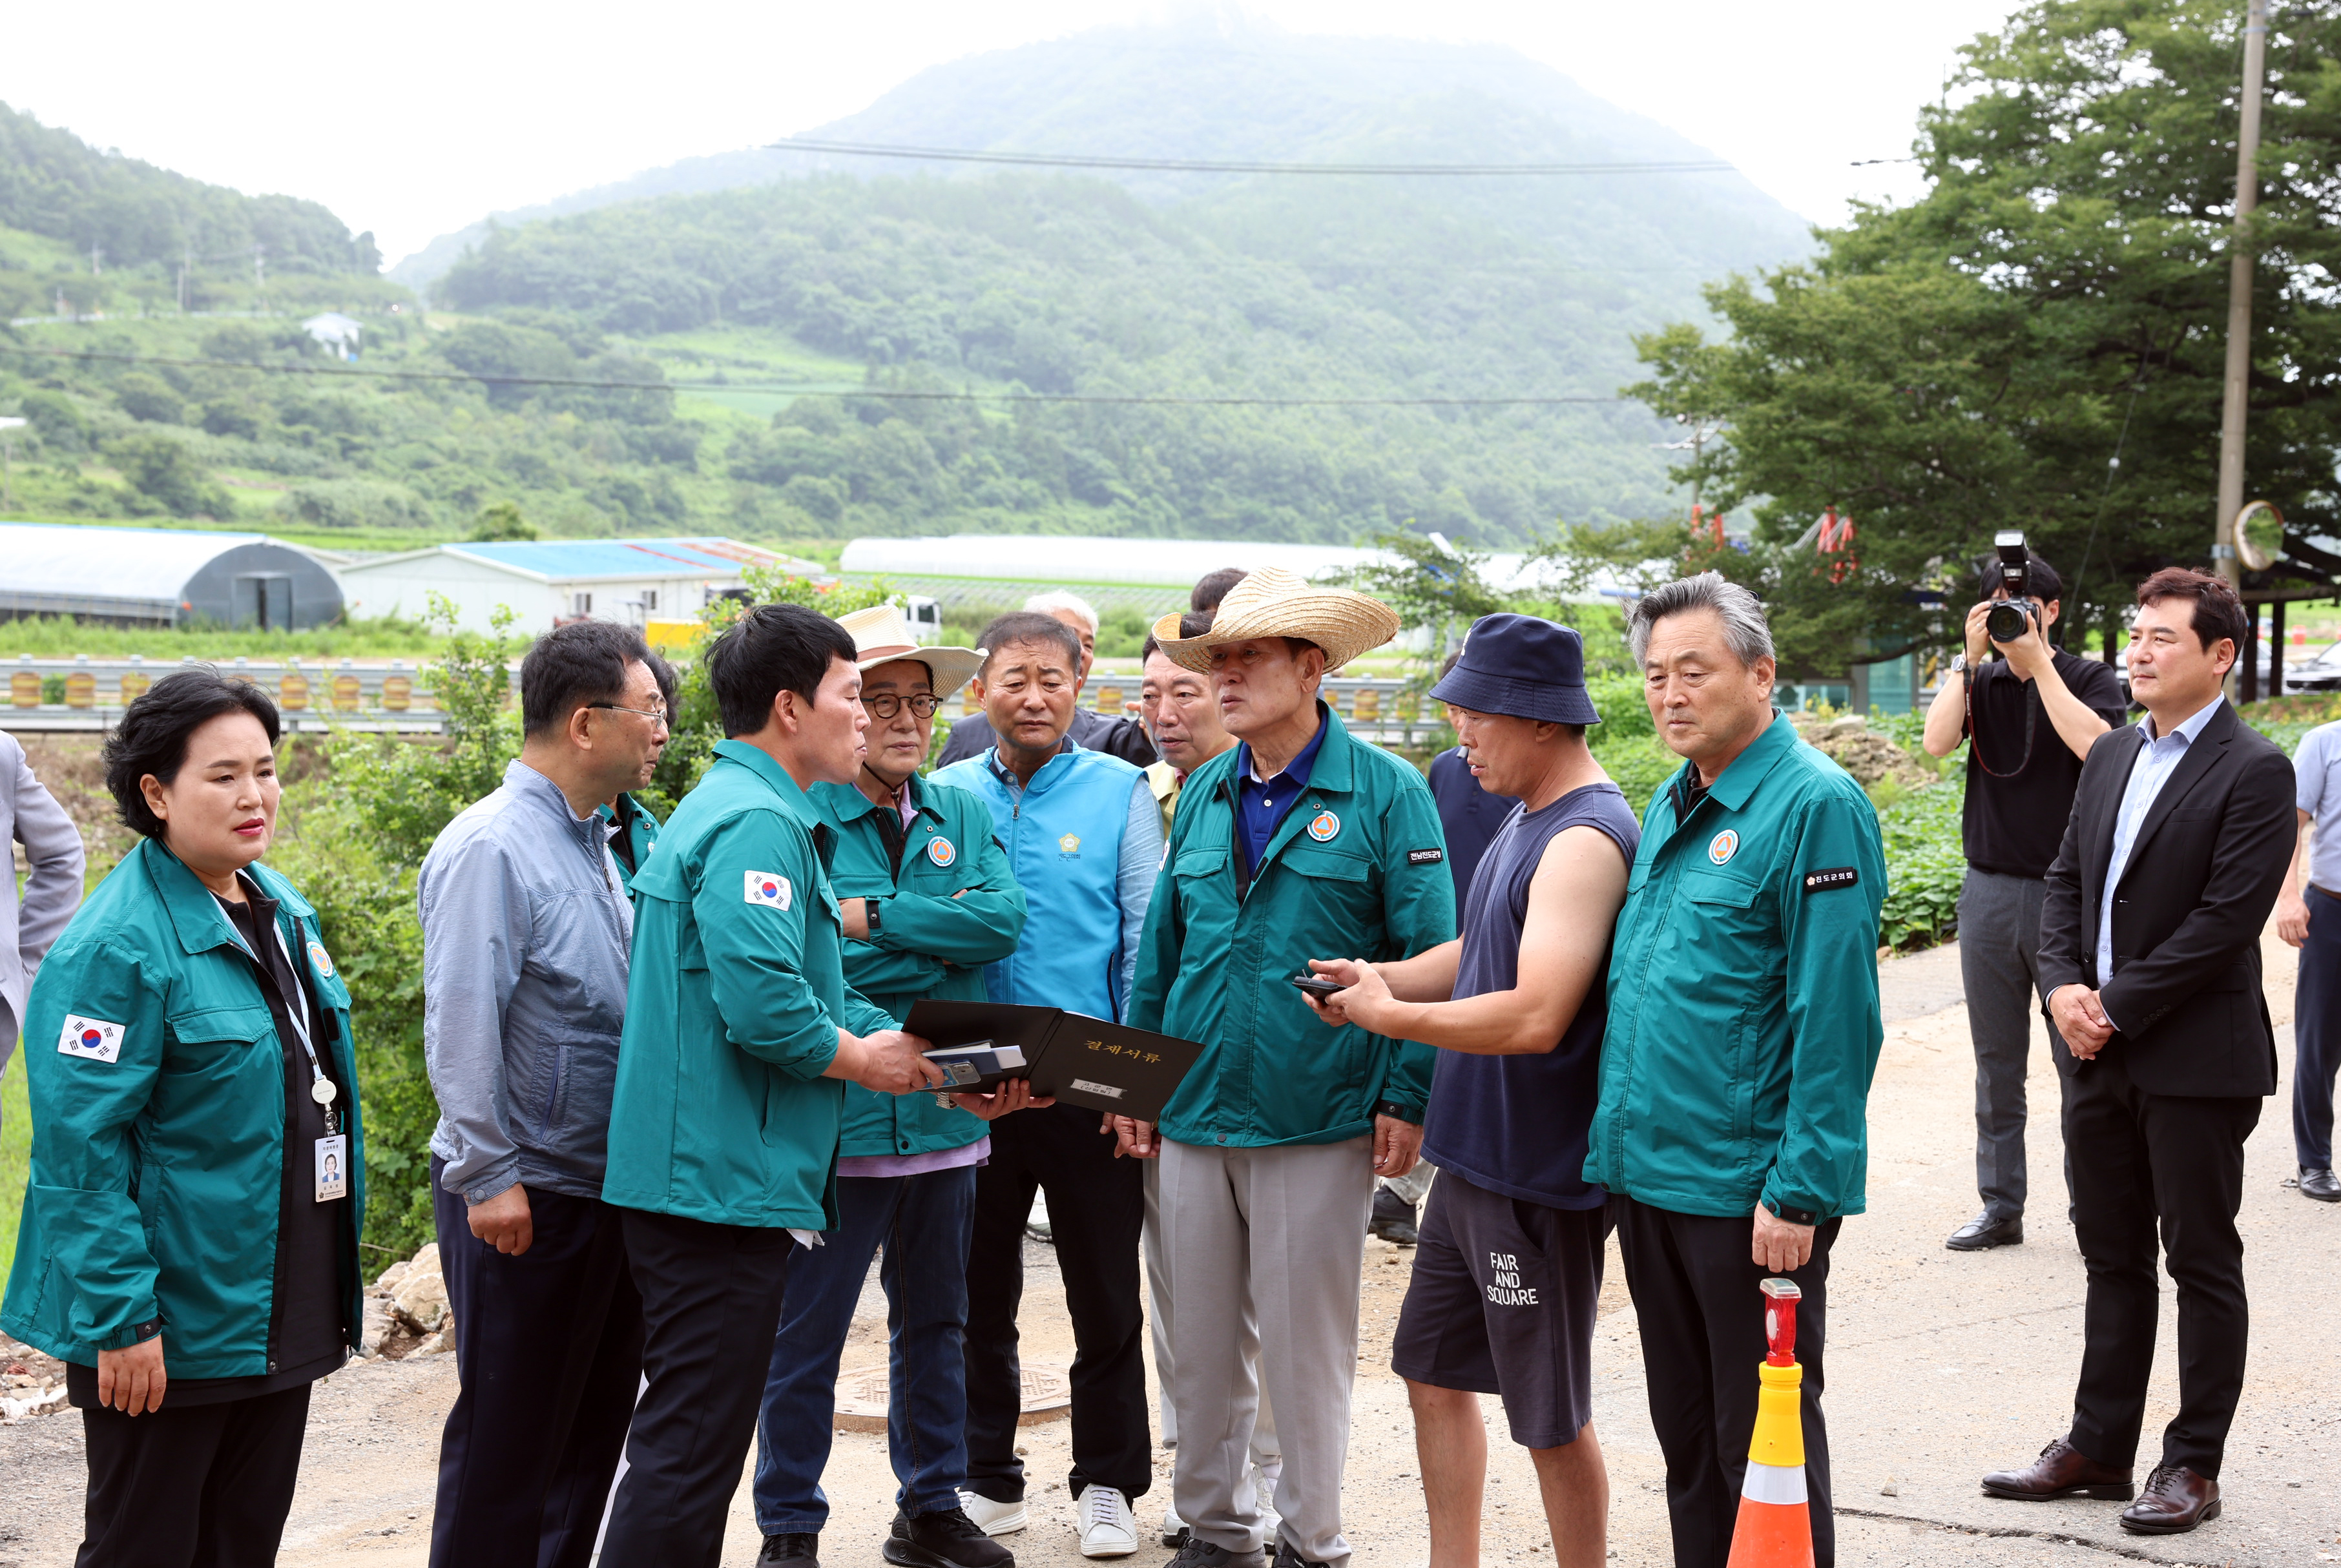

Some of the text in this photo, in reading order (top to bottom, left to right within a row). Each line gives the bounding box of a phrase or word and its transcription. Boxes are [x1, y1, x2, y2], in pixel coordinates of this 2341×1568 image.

[1058, 853, 1081, 861] 진도군의회
[1410, 850, 1441, 861] 전남진도군청
[1815, 871, 1853, 883] 진도군의회
[1083, 1040, 1161, 1064] 결재서류
[1490, 1252, 1519, 1270] FAIR
[1495, 1270, 1521, 1288] AND
[1486, 1284, 1539, 1306] SQUARE
